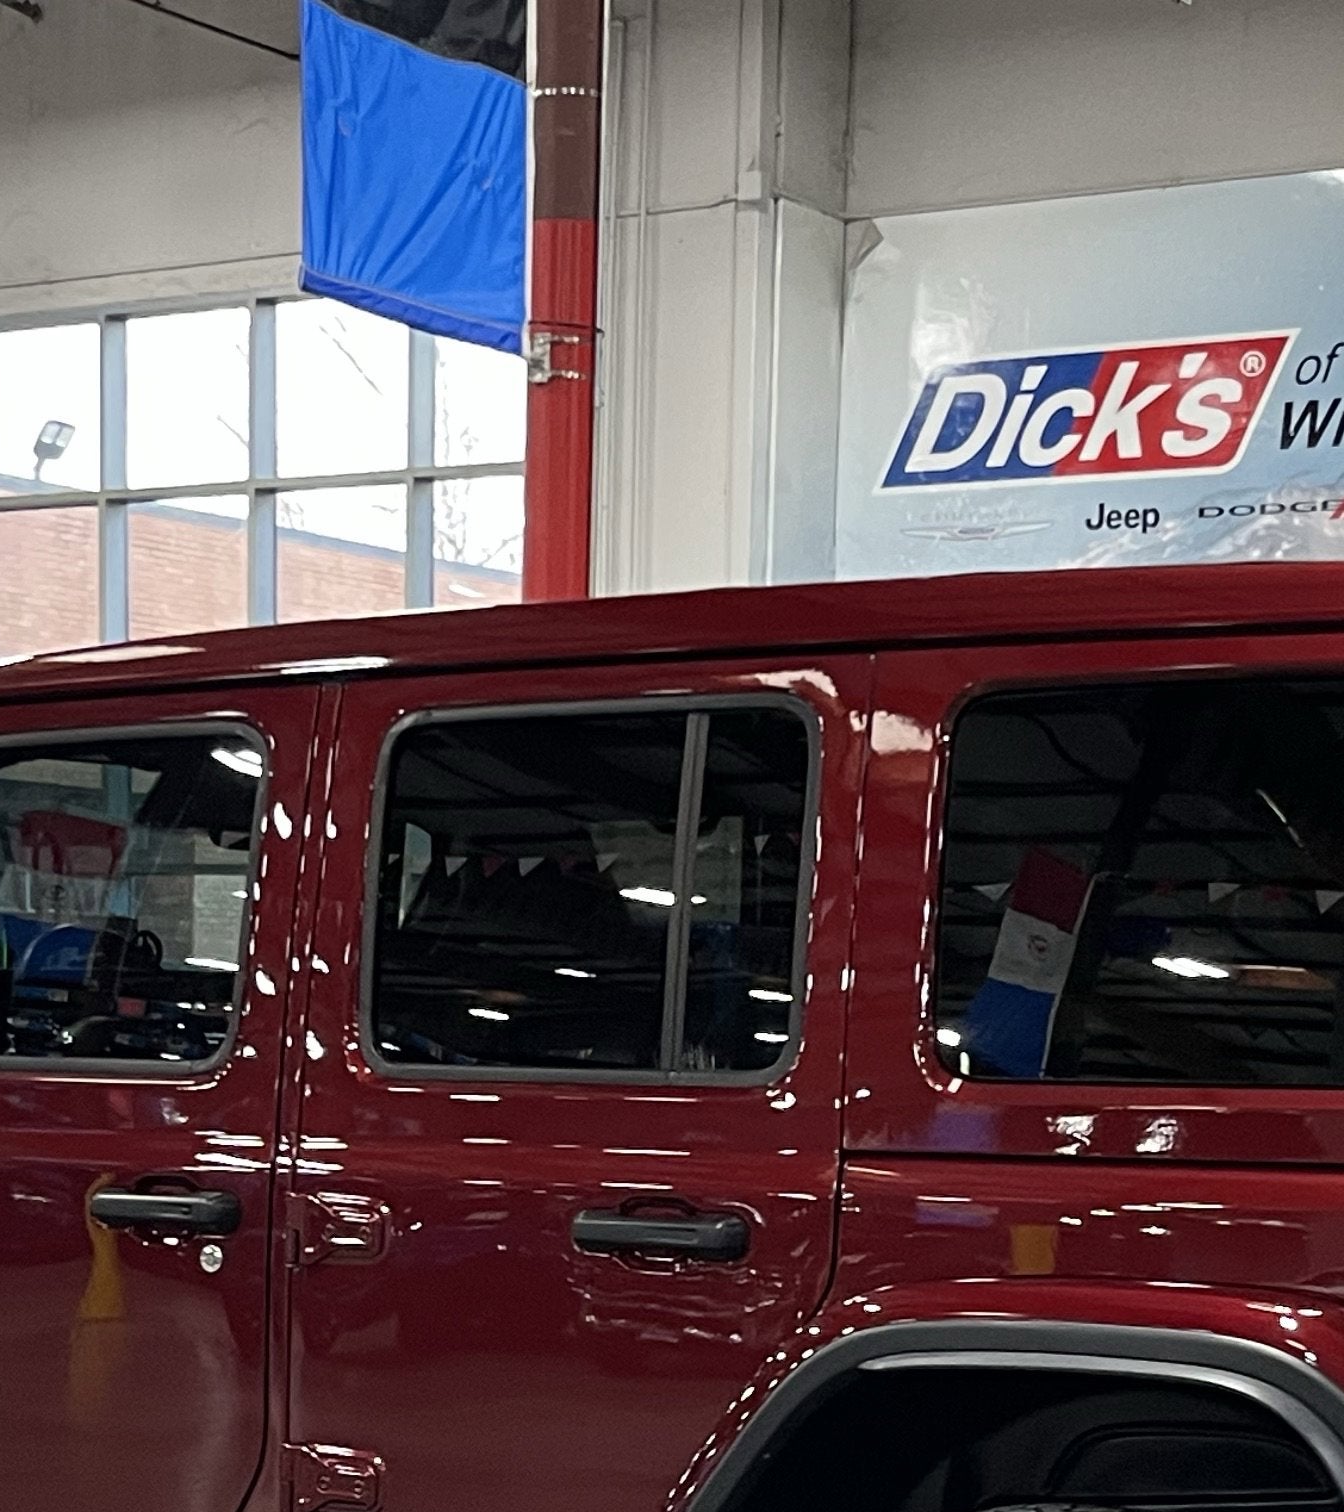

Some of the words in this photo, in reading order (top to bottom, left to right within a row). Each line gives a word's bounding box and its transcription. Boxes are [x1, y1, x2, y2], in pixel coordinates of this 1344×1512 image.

[903, 351, 1244, 475] Dick's
[1085, 503, 1161, 534] Jeep
[1197, 498, 1344, 519] DODGE
